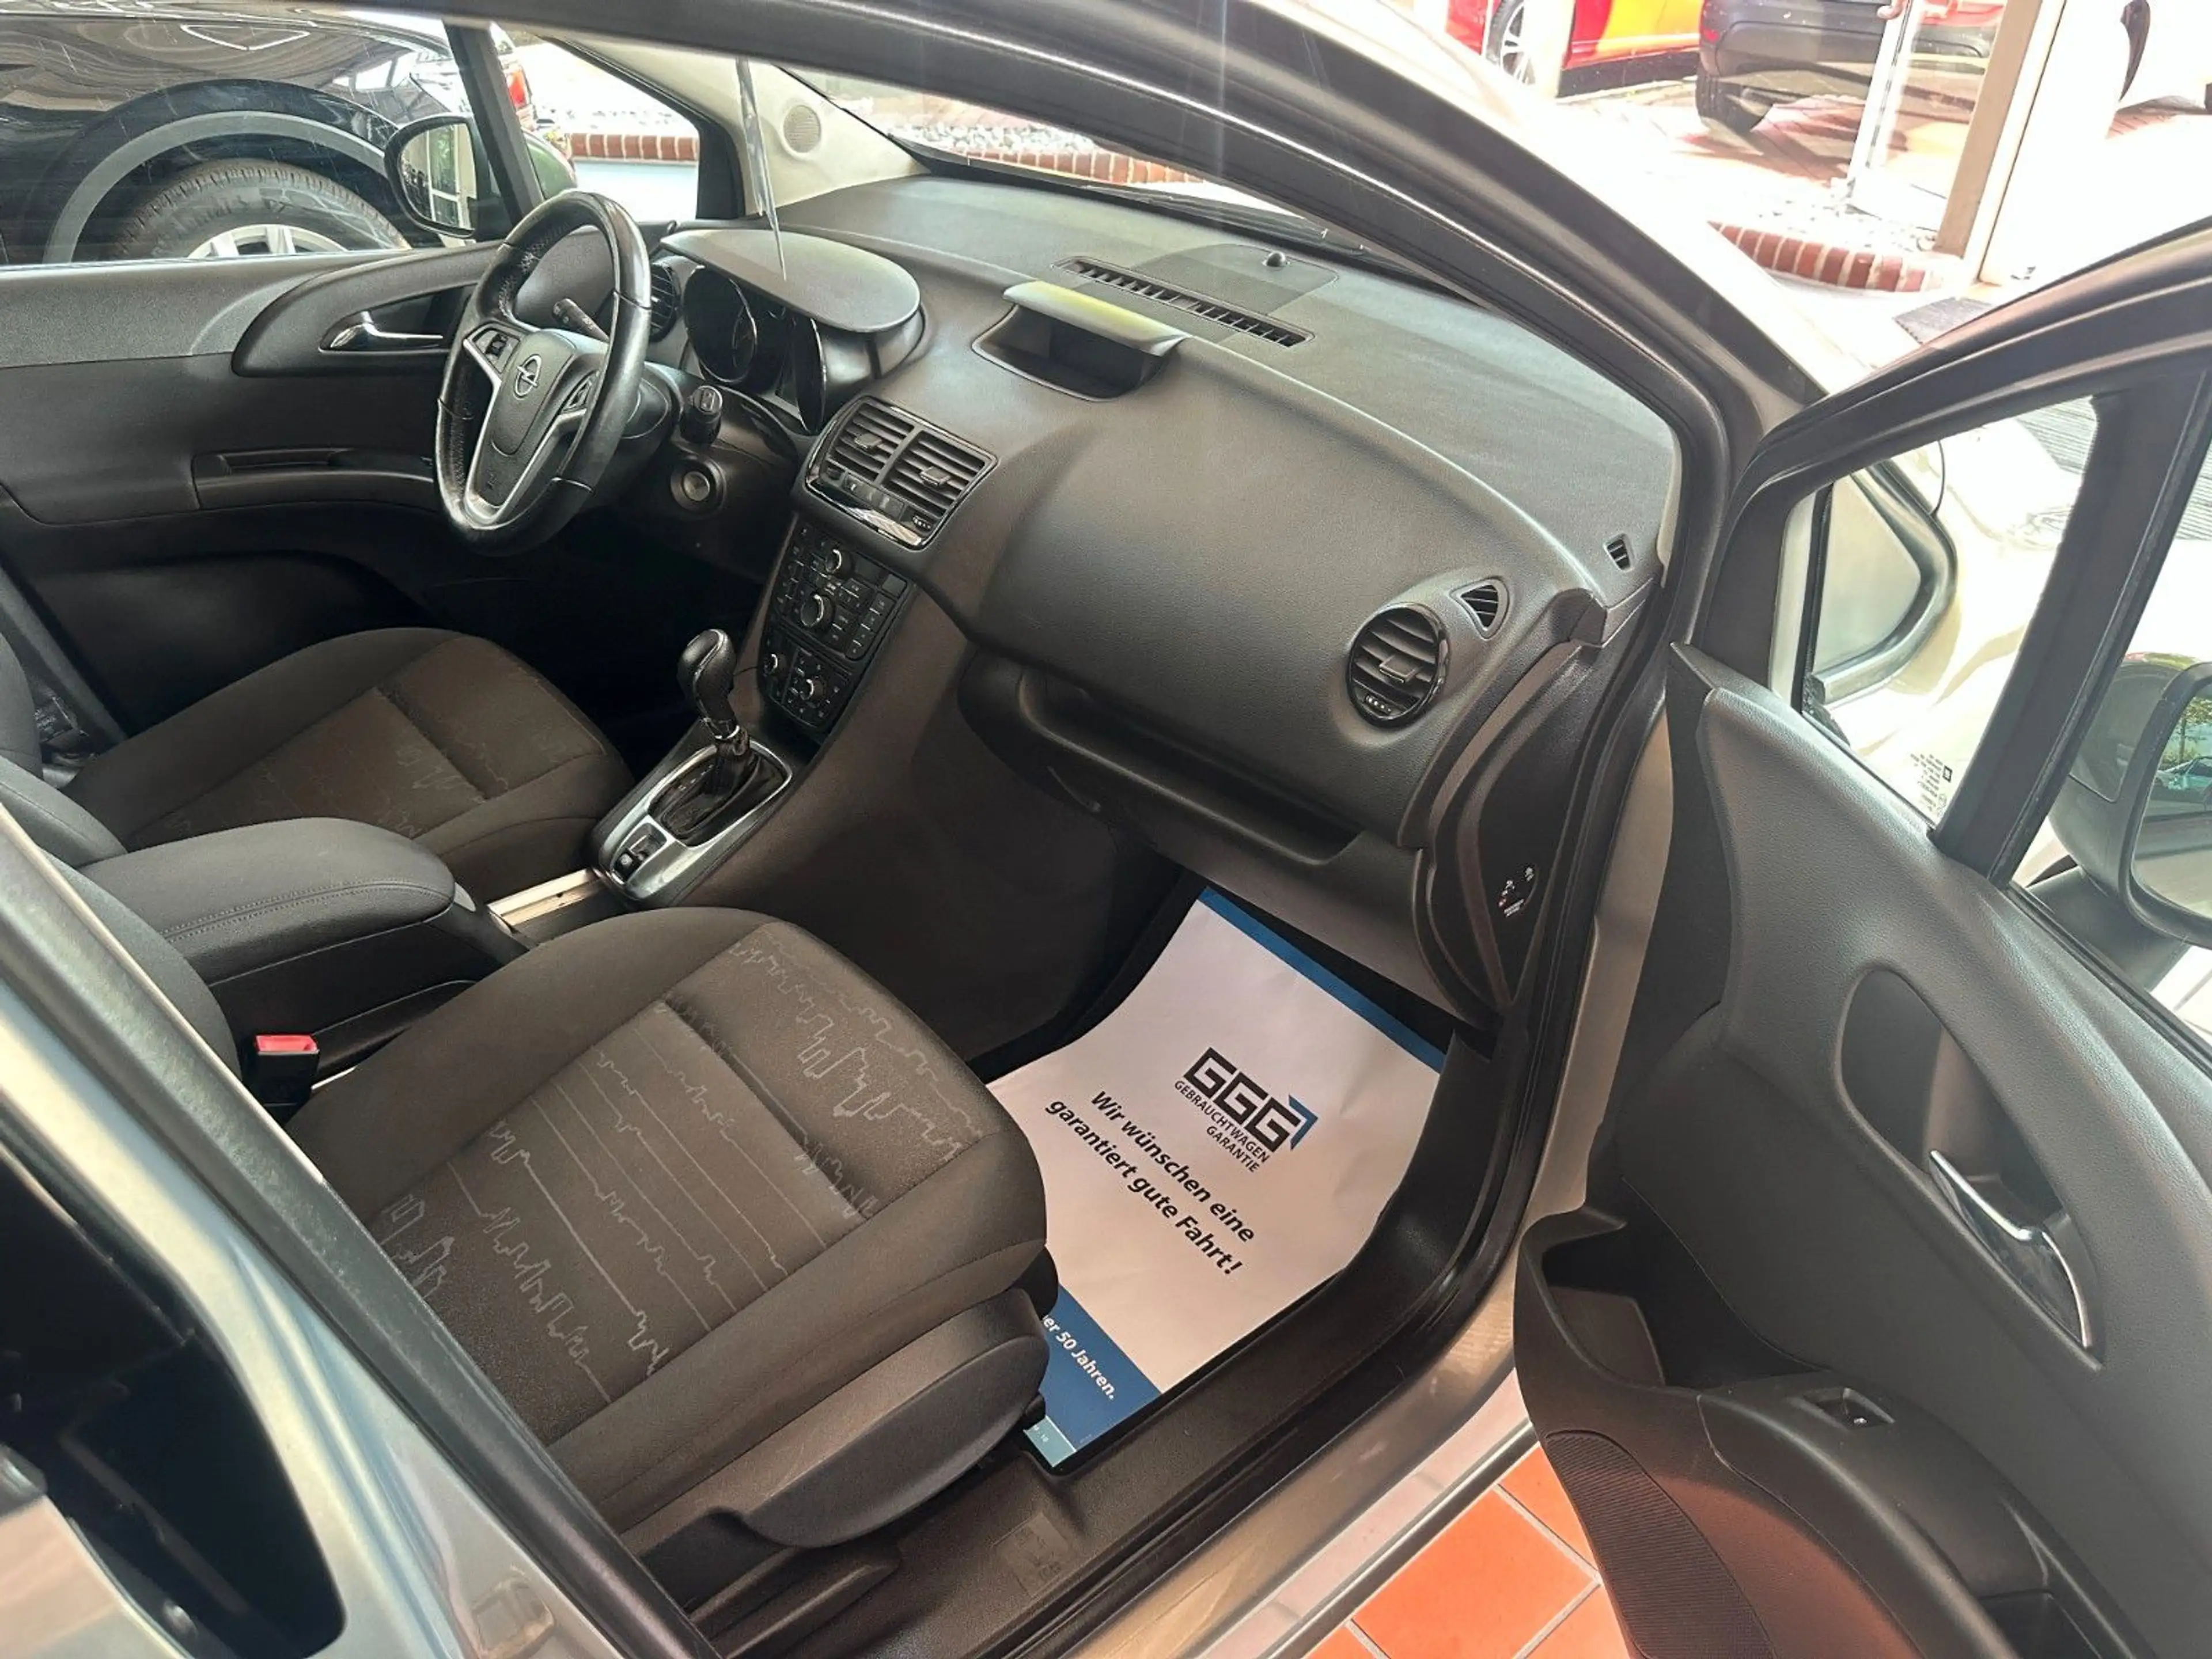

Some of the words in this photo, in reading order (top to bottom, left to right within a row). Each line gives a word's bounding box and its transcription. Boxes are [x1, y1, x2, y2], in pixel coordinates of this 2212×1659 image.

[1175, 1080, 1271, 1163] GEBRAUCHTWAGEN
[1183, 1047, 1302, 1153] GGG
[1045, 1101, 1137, 1178] garantiert
[1127, 1177, 1179, 1218] gute
[1175, 1215, 1243, 1275] Fahrt!
[1091, 1090, 1125, 1122] Wir
[1121, 1120, 1211, 1203] wünschen
[1210, 1202, 1255, 1243] eine
[1206, 1126, 1260, 1173] GARANTIE
[1043, 1315, 1060, 1332] er
[1055, 1331, 1077, 1349] 50
[1071, 1349, 1115, 1400] Jahren.
